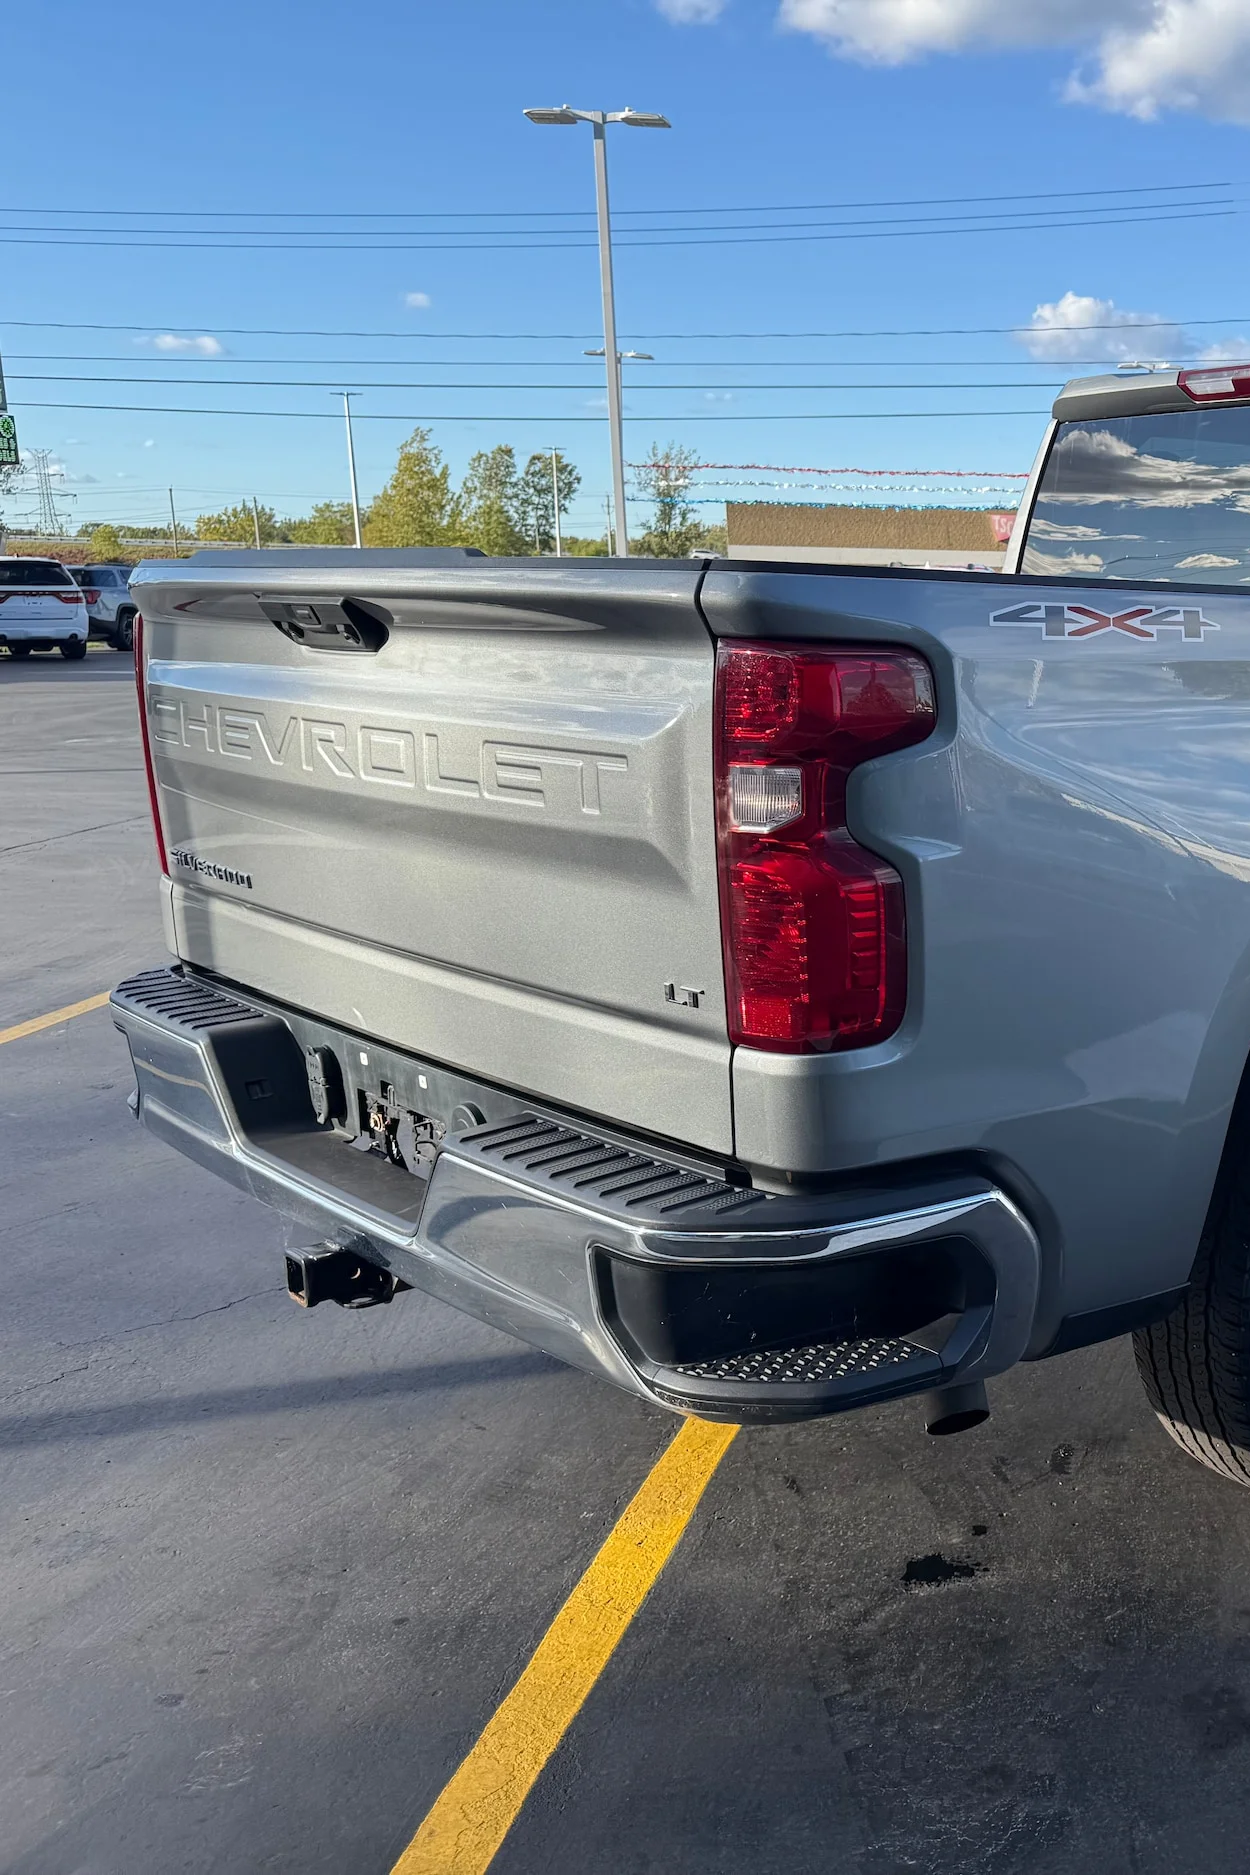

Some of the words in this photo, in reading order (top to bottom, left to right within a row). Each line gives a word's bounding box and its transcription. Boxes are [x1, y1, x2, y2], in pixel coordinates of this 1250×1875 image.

[152, 693, 630, 815] CHEVROLET
[170, 848, 254, 889] SILVERADO
[664, 981, 705, 1009] LT
